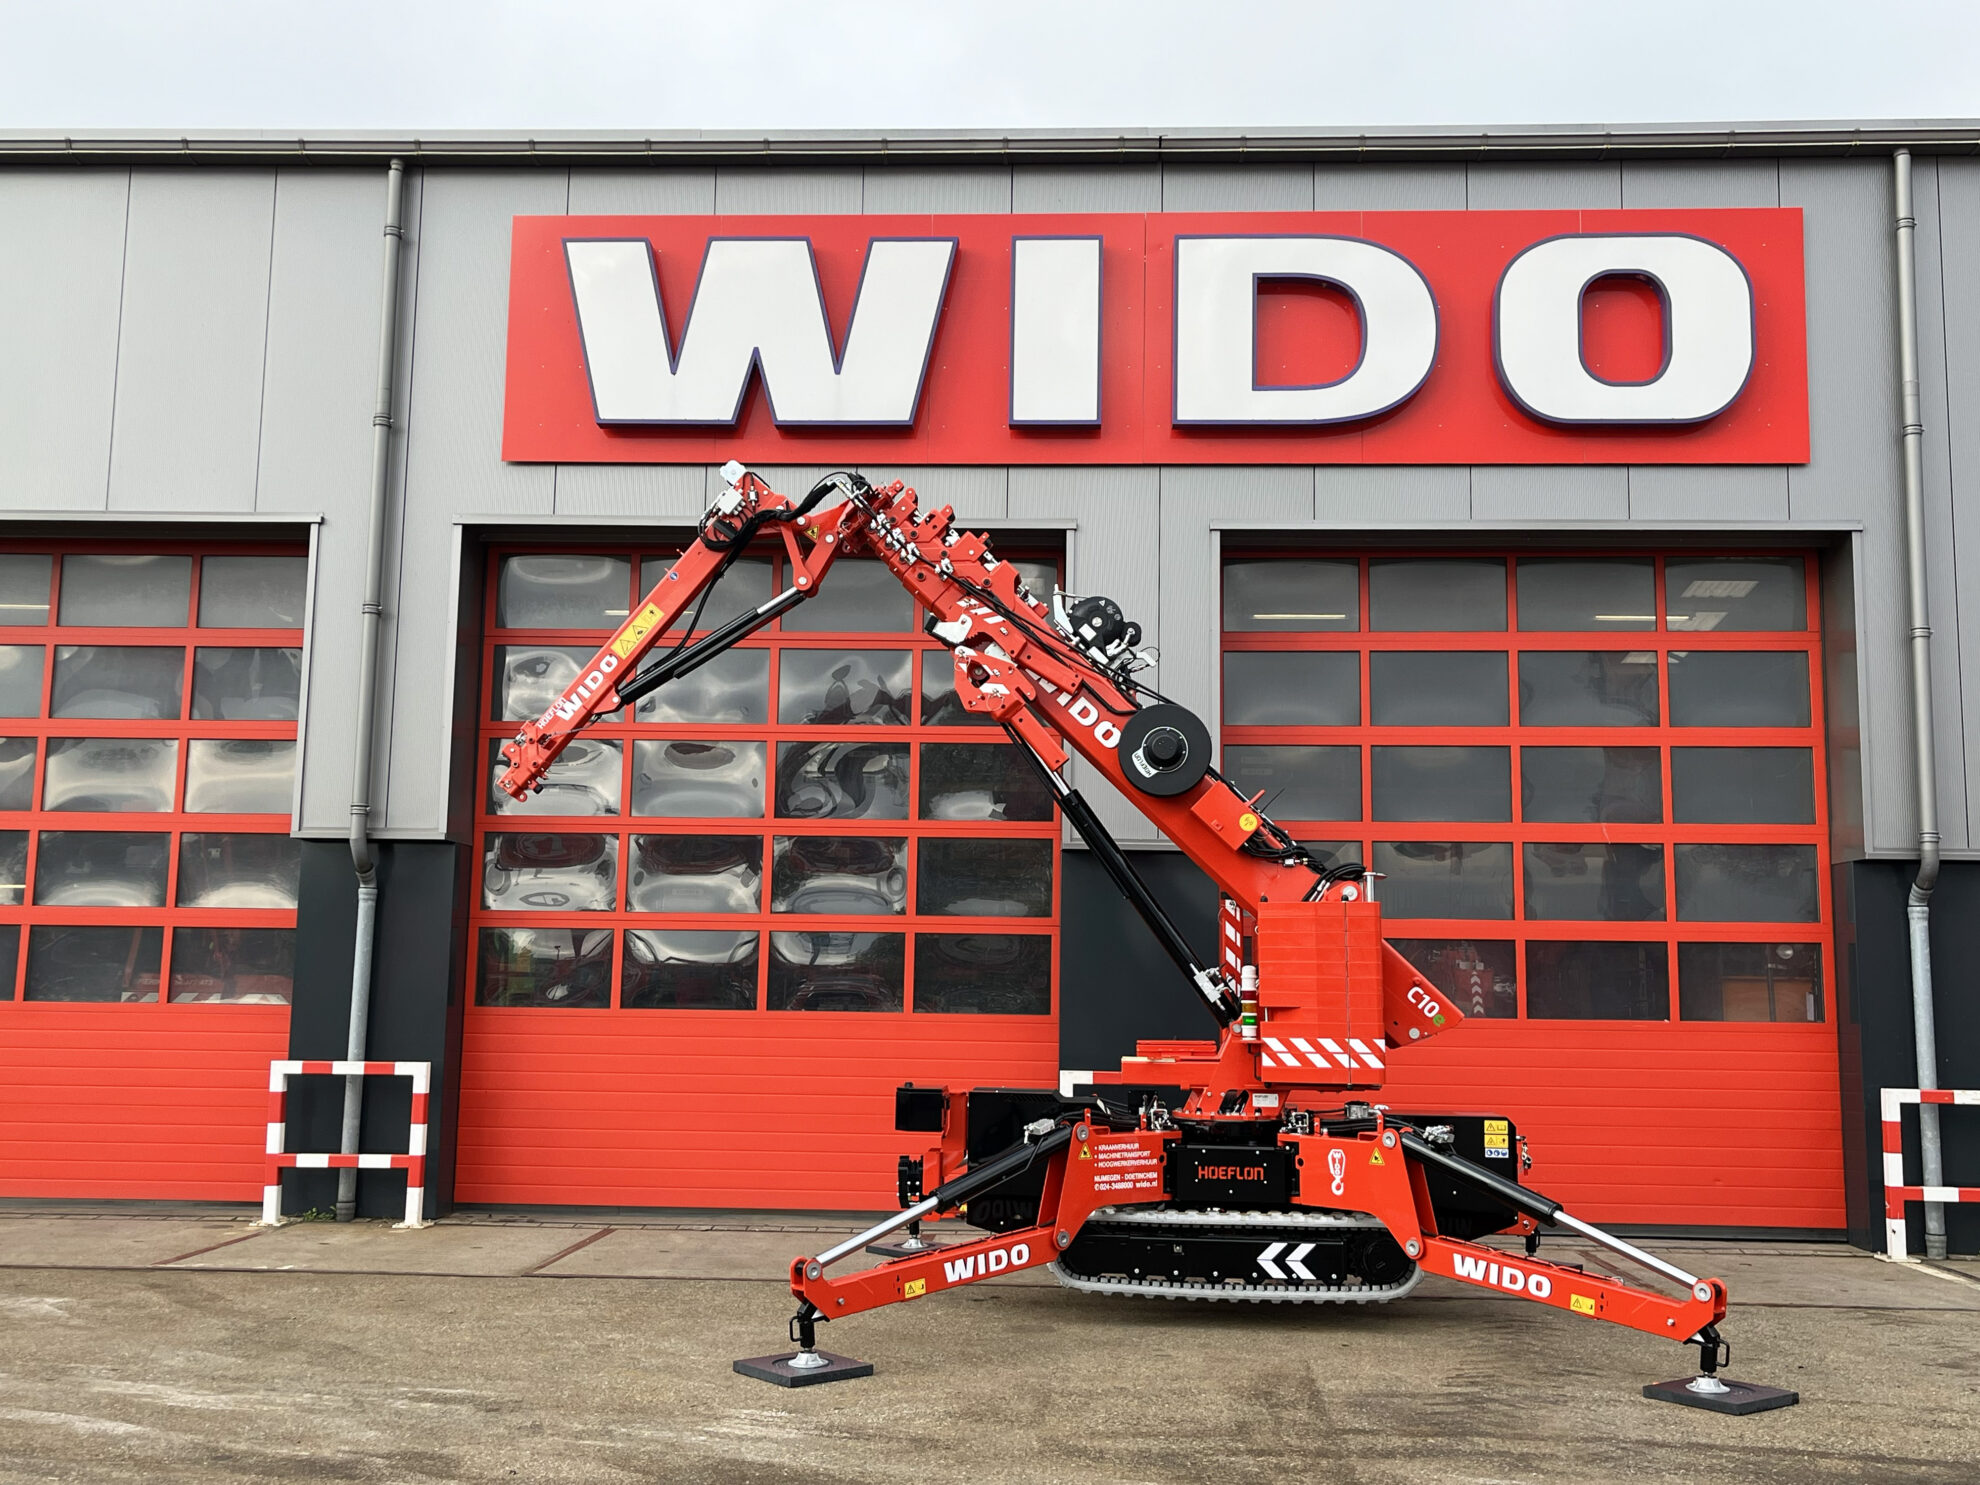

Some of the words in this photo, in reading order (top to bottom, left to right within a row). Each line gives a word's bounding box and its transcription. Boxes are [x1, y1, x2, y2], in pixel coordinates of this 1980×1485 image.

[561, 233, 1757, 430] WIDO
[557, 653, 619, 721] WIDO
[1098, 1143, 1140, 1151] KRAANVERHUUR
[1098, 1150, 1151, 1160] MACHINETRANSPORT
[1098, 1159, 1158, 1168] HOOGWERKERVERHUUR
[1094, 1174, 1121, 1182] NIJMEGEN
[1124, 1172, 1158, 1181] DOETINCHEM
[1198, 1165, 1264, 1181] HOEFLON
[1135, 1180, 1158, 1188] wido.nl
[944, 1243, 1031, 1283] WIDO
[1453, 1253, 1552, 1299] WIDO
